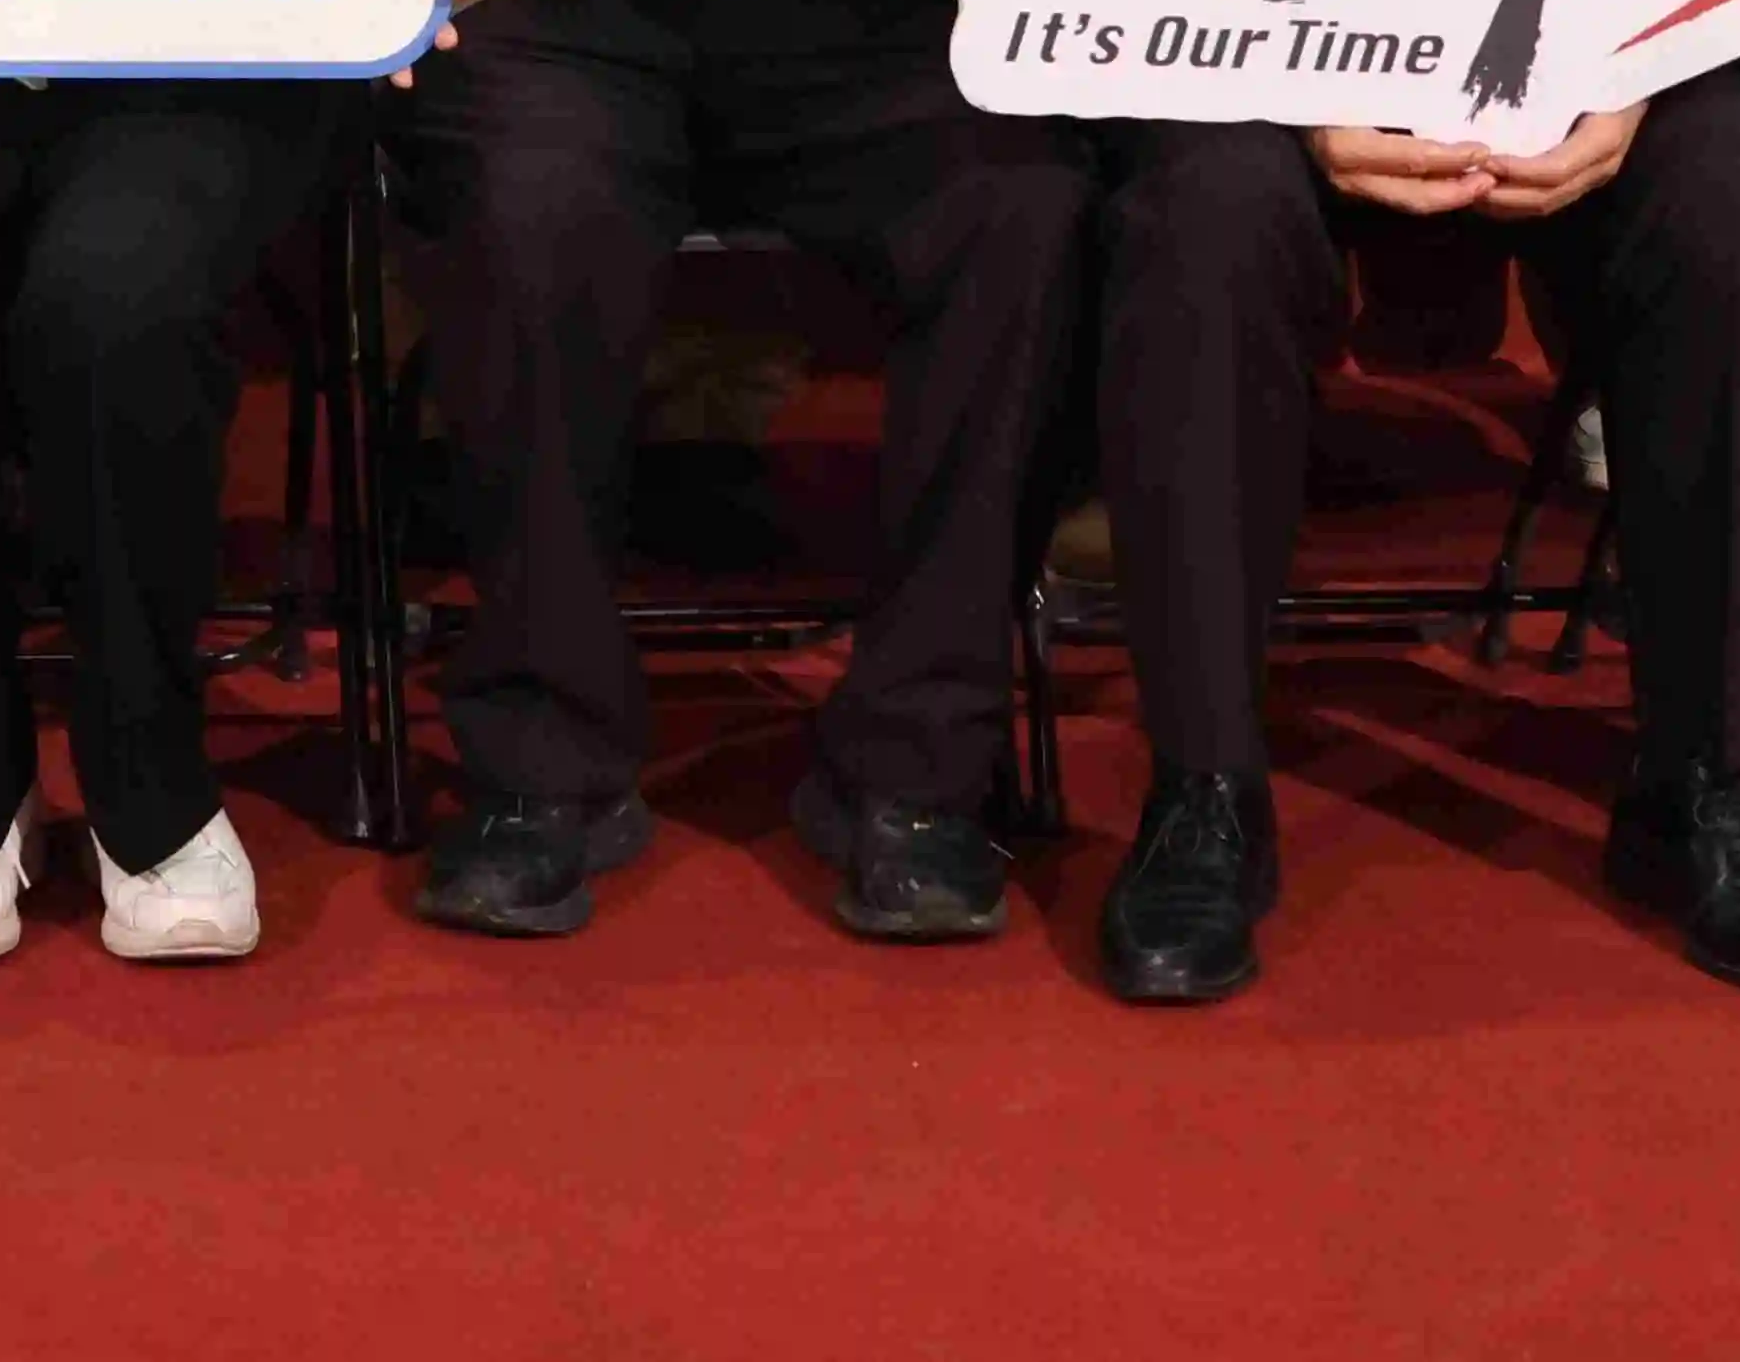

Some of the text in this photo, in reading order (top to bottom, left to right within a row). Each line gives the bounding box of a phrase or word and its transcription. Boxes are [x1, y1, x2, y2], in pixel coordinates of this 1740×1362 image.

[1006, 11, 1444, 77] It's Our Time
